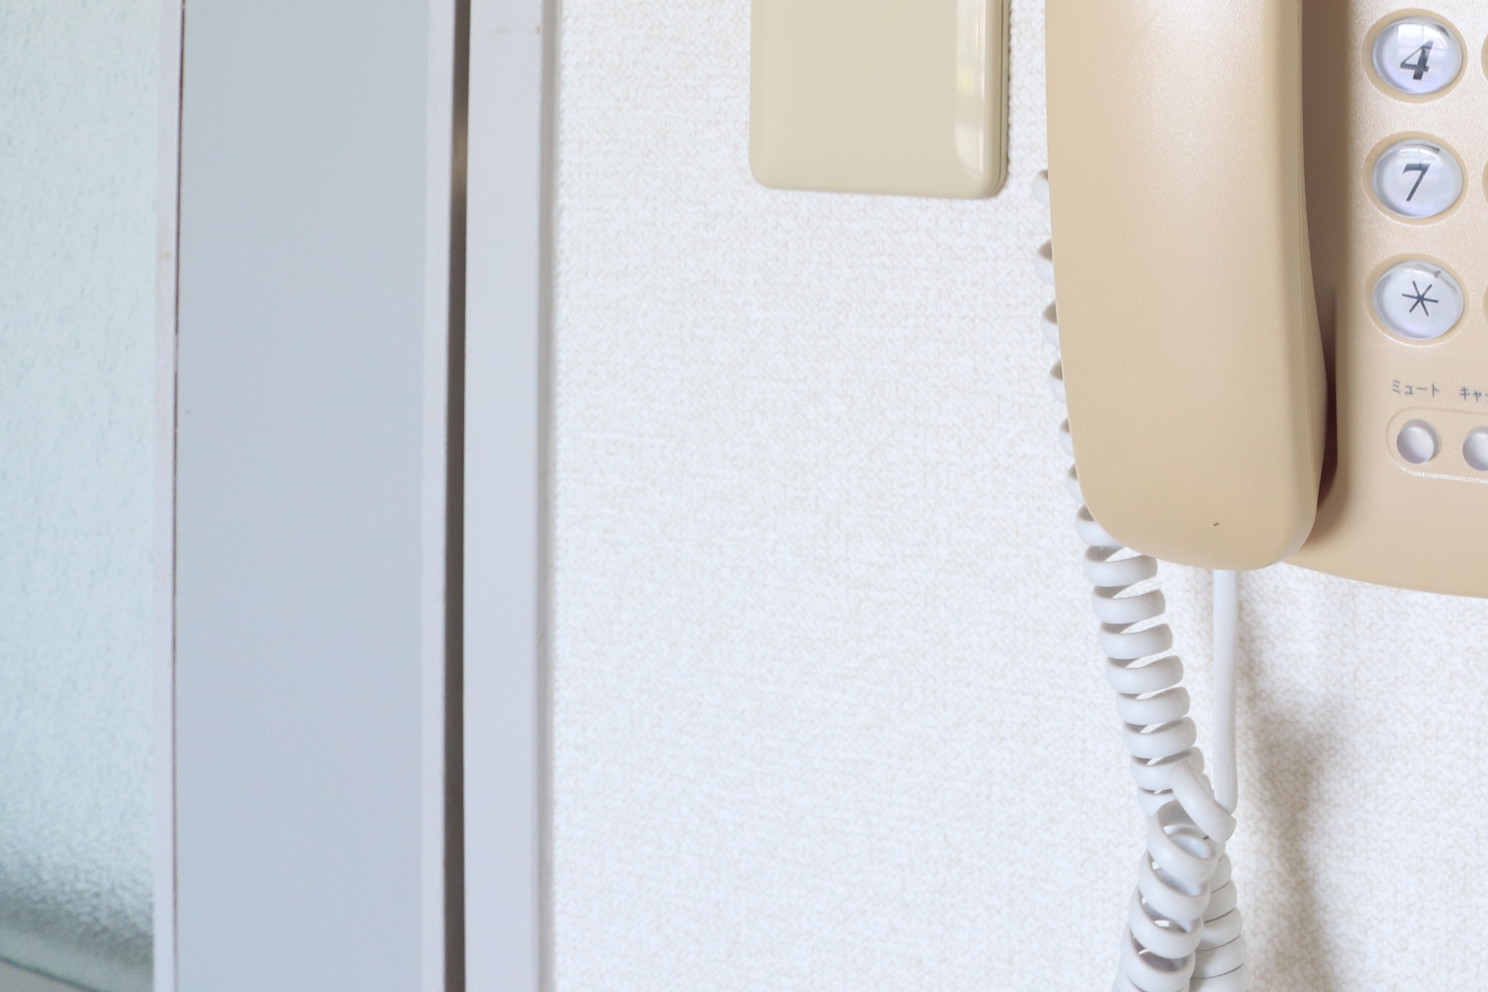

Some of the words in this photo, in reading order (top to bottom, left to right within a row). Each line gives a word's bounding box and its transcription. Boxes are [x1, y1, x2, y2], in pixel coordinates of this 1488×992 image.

[1399, 40, 1434, 81] 4
[1401, 163, 1430, 202] 7
[1391, 379, 1440, 398] ミュート
